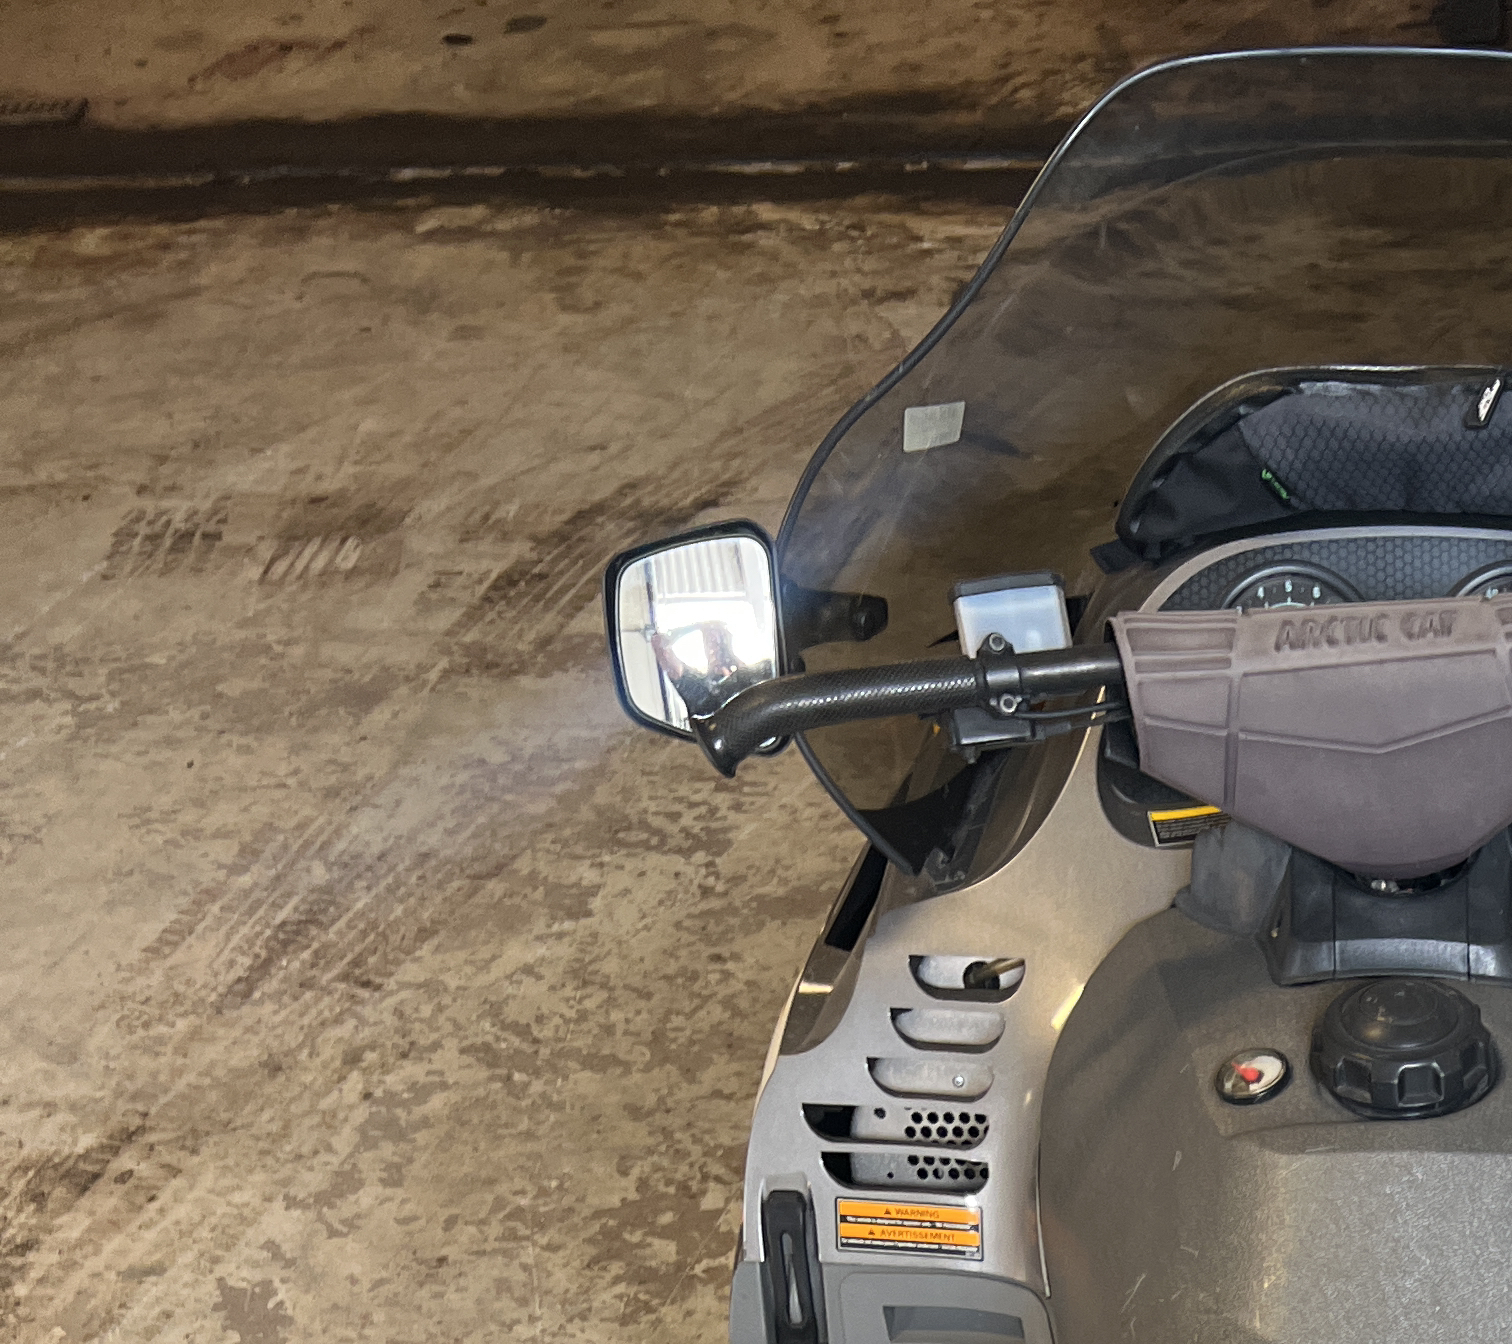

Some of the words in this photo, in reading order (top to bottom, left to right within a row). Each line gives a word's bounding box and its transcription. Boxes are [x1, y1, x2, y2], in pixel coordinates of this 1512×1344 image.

[1274, 613, 1391, 653] ARCTIC
[1400, 609, 1458, 642] CAT
[894, 1207, 940, 1219] WARNING
[880, 1228, 956, 1242] AVERTISSEMENT
